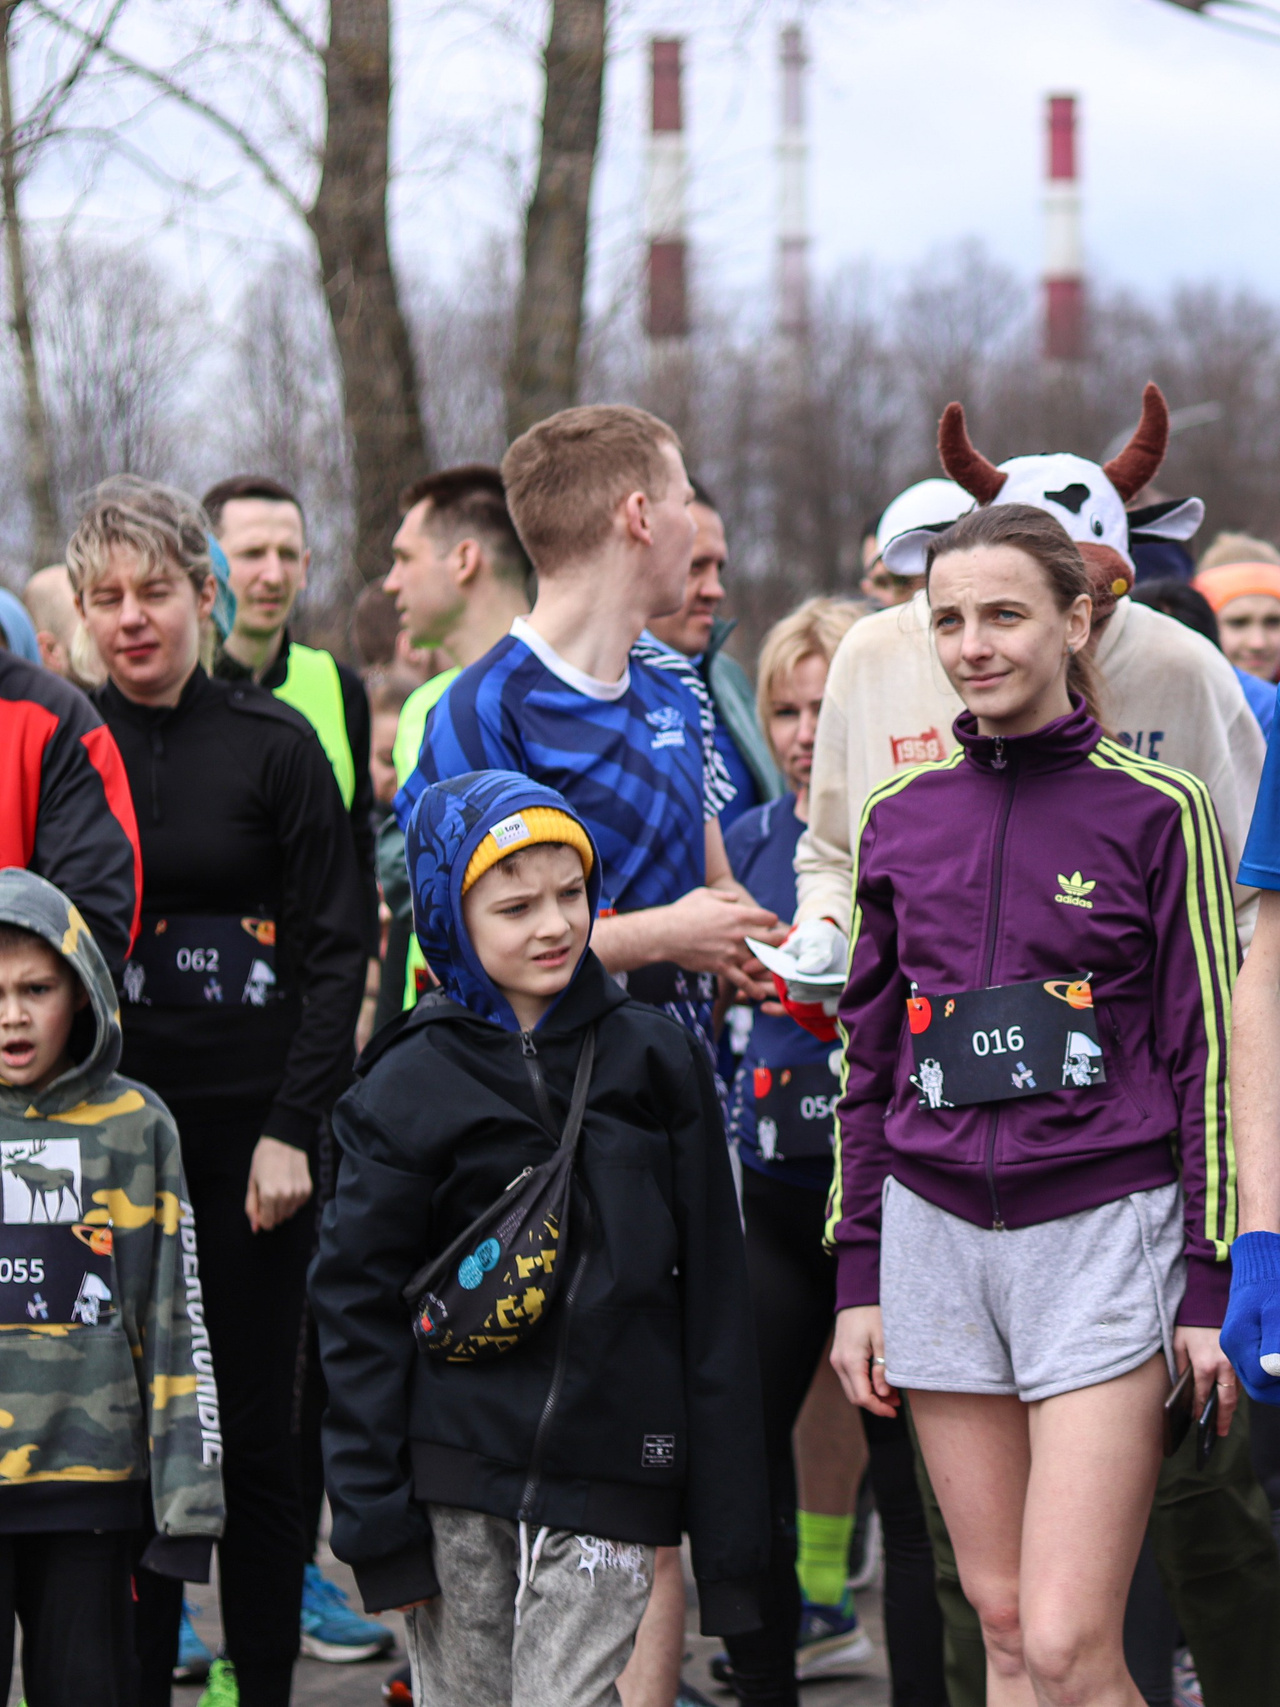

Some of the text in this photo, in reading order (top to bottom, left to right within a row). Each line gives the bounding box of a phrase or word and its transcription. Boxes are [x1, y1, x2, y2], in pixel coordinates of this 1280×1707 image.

[1054, 893, 1094, 910] adidas
[176, 947, 220, 973] 062
[972, 1025, 1025, 1057] 016
[0, 1257, 45, 1284] 055
